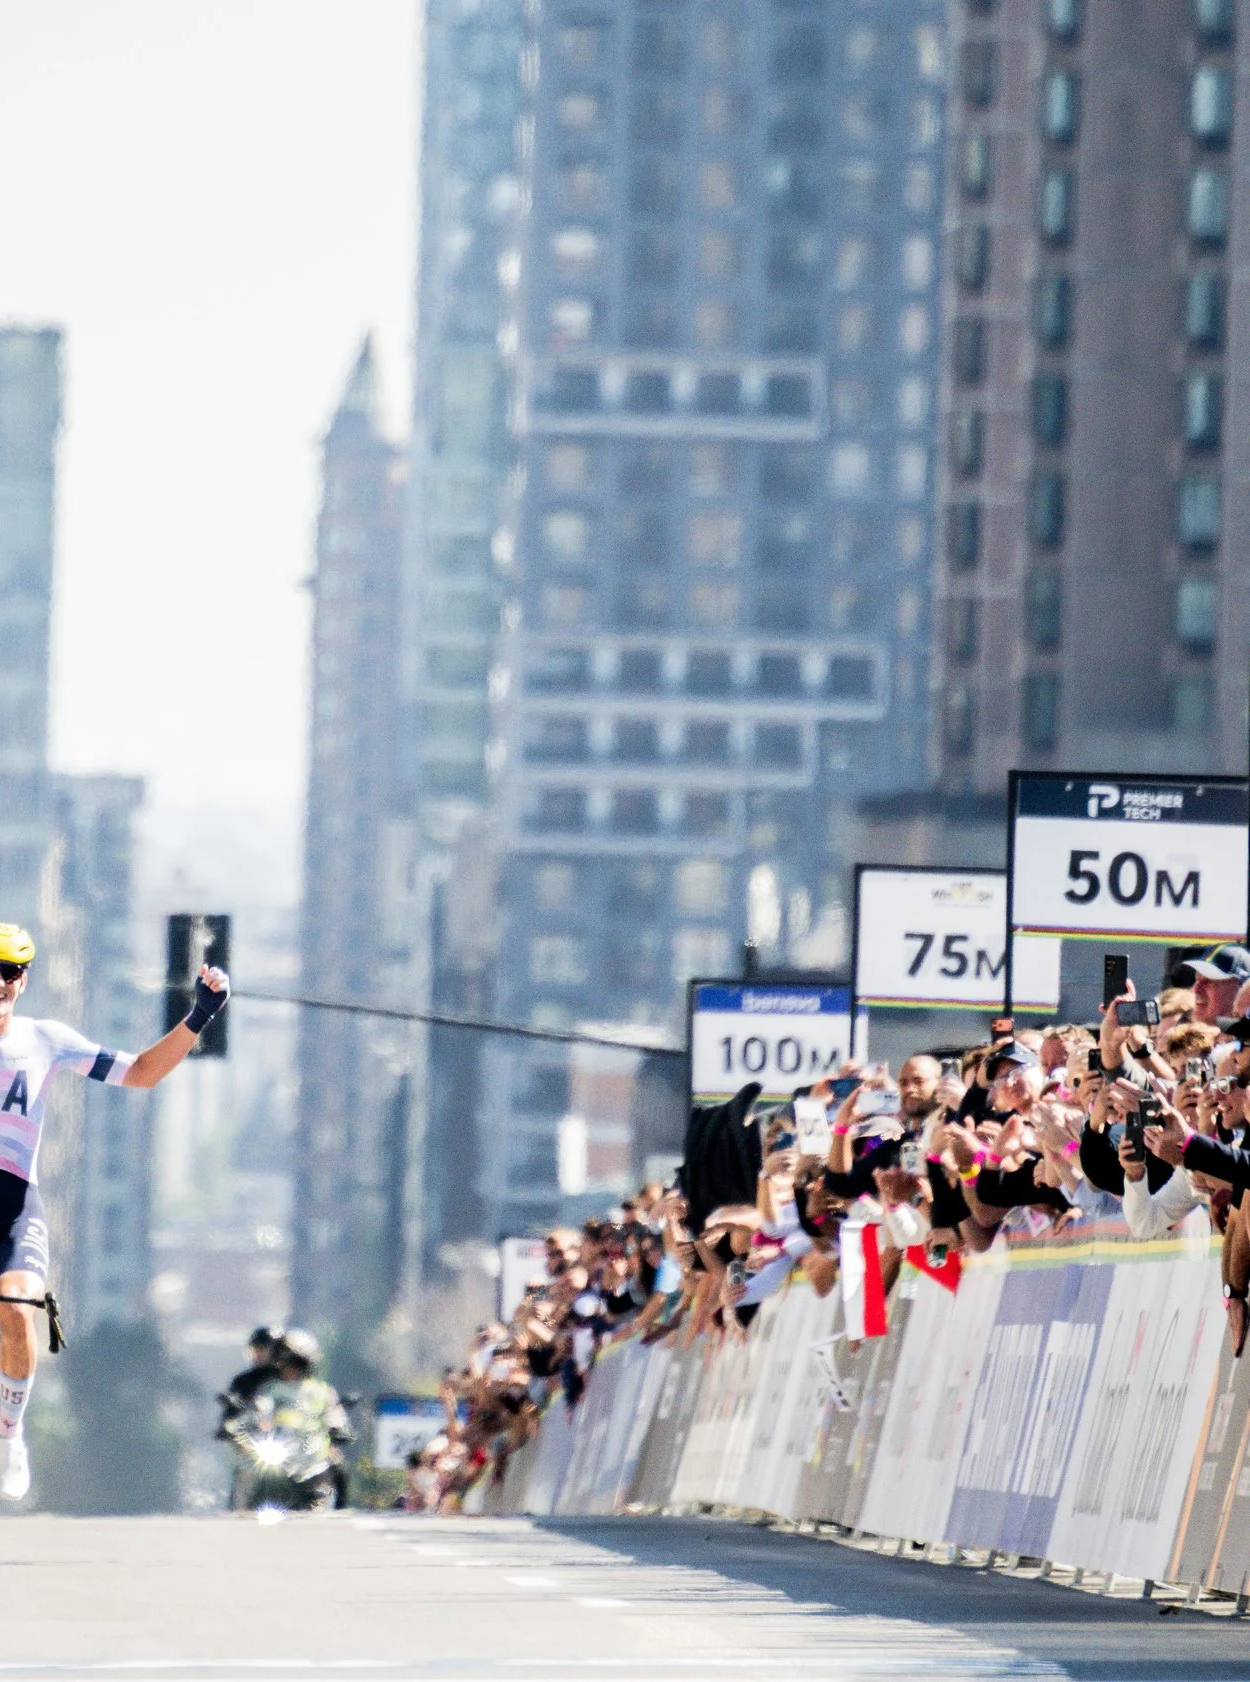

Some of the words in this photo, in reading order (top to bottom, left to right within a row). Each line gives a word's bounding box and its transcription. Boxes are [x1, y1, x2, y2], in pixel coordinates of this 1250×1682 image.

[1123, 790, 1184, 808] PREMIER
[1123, 807, 1161, 821] TECH
[1063, 849, 1201, 909] 50M
[721, 1035, 839, 1074] 100M
